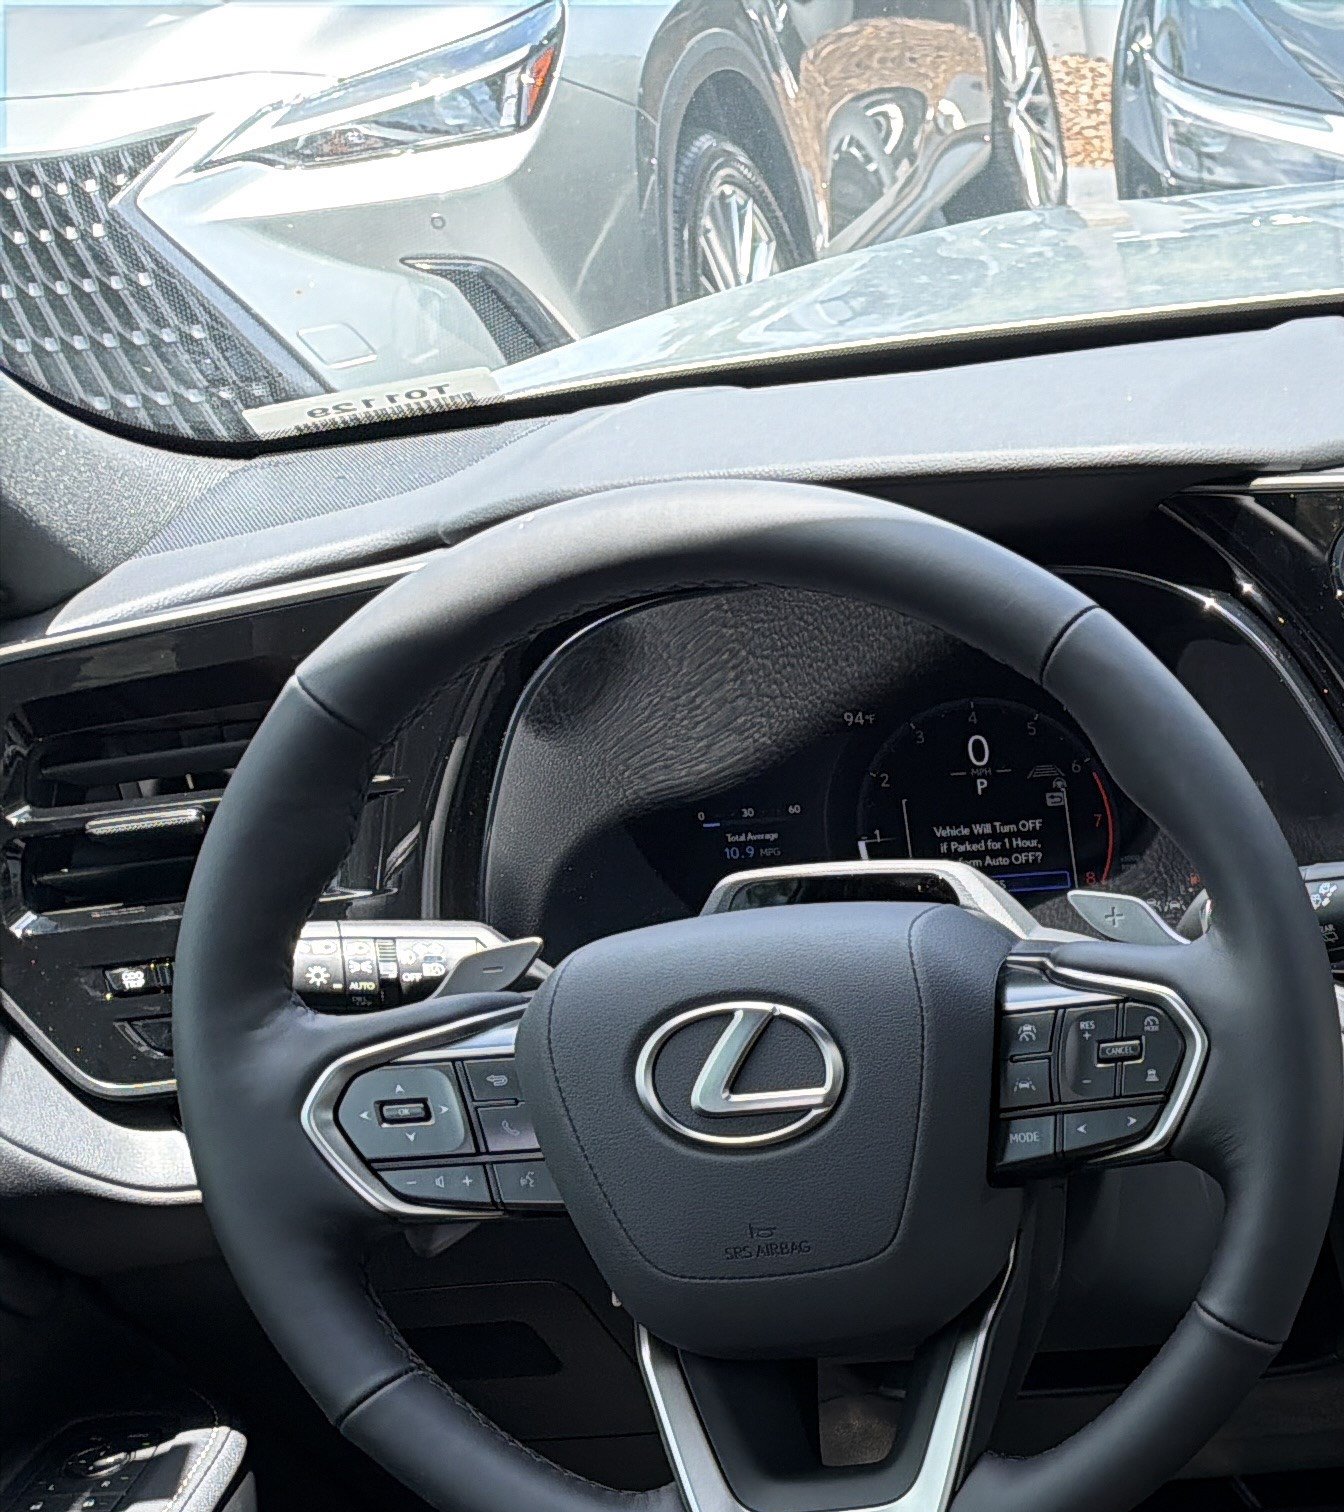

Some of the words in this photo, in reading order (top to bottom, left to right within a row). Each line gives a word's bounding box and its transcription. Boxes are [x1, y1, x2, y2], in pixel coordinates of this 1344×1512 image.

[967, 711, 979, 725] 4
[1027, 722, 1037, 736] 5
[916, 731, 926, 744] 3
[967, 734, 990, 767] 0
[970, 767, 993, 777] MPH
[1071, 761, 1082, 774] 6
[879, 773, 891, 788] 2
[975, 778, 989, 796] P
[741, 807, 755, 818] 30
[788, 804, 801, 814] 60
[933, 826, 971, 838] Vehicle
[971, 823, 993, 835] Will
[993, 821, 1018, 834] Turn
[1018, 819, 1043, 832] OFF
[725, 833, 746, 843] Total
[746, 832, 779, 842] Average
[724, 845, 756, 860] 10.9
[759, 847, 782, 857] MPG
[939, 841, 948, 854] if
[950, 839, 986, 853] Parked
[986, 838, 1002, 850] for
[1004, 837, 1010, 849] 1
[984, 855, 1010, 867] Auto
[1011, 852, 1043, 865] OFF?
[401, 972, 423, 983] OFF
[349, 981, 376, 991] AUTO
[1079, 1020, 1096, 1030] RES
[1105, 1046, 1134, 1056] CANCEL
[1009, 1132, 1040, 1144] MODE
[724, 1245, 753, 1260] SRS
[755, 1240, 812, 1258] AIRBAG
